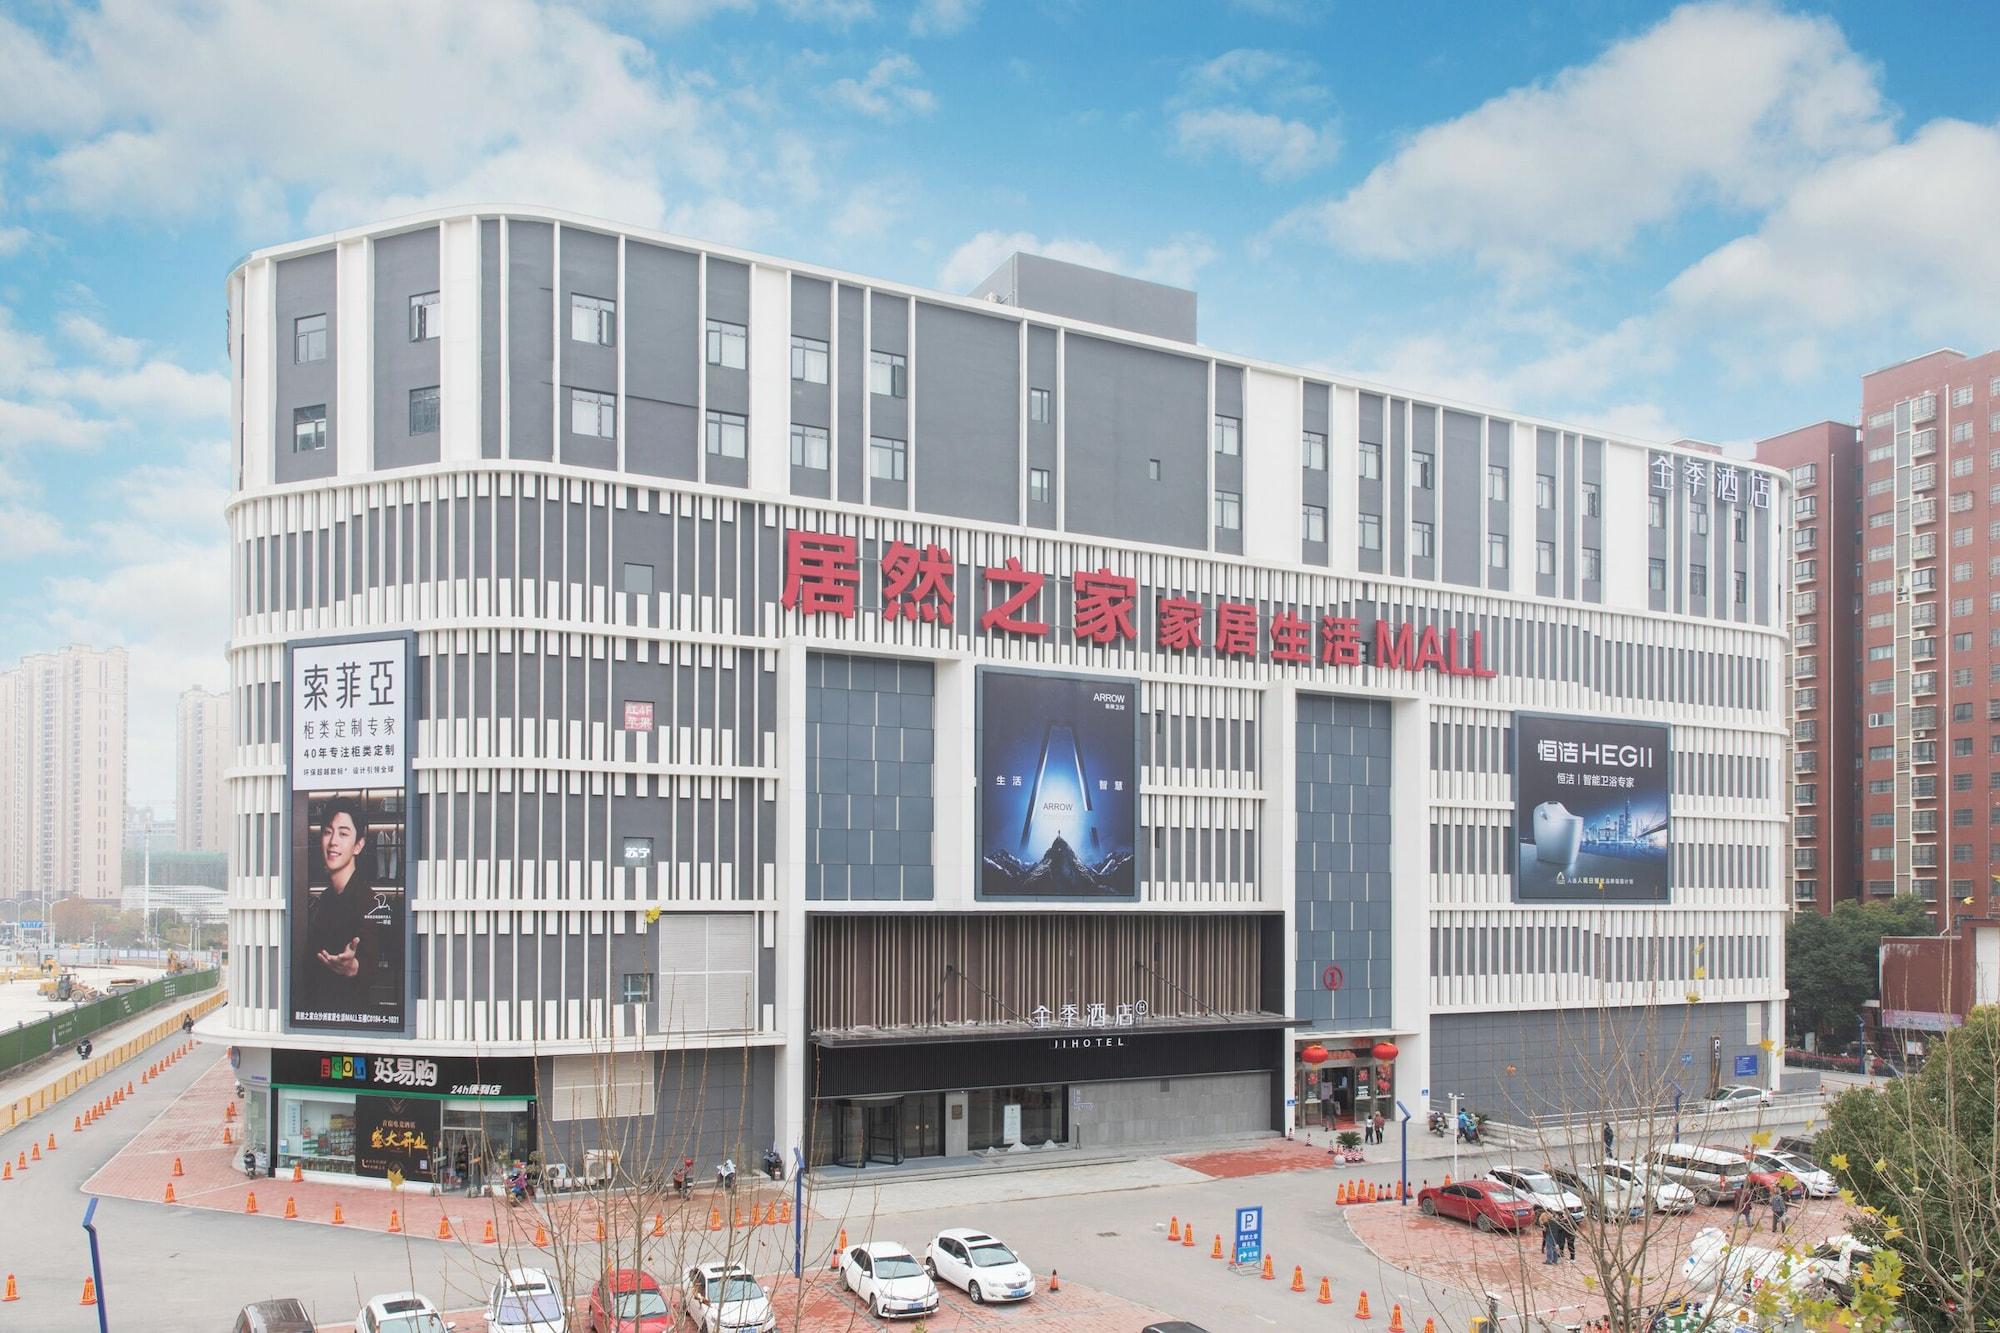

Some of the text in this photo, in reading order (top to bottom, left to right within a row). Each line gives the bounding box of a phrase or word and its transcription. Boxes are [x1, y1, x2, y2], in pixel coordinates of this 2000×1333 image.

[1651, 455, 1771, 509] 全季酒店
[781, 530, 1137, 644] 居然之家
[1375, 619, 1498, 679] MALL
[1093, 692, 1125, 703] ARROW
[304, 716, 395, 740] 柜类定制专家
[303, 744, 395, 759] 40年专注柜类定制
[996, 775, 1124, 791] 生活 智慧
[1043, 802, 1073, 811] ARROW
[624, 847, 651, 859] 苏宁
[1031, 1003, 1134, 1028] 全季酒店
[373, 1057, 438, 1087] 好易购
[371, 1126, 428, 1157] 盛大开业
